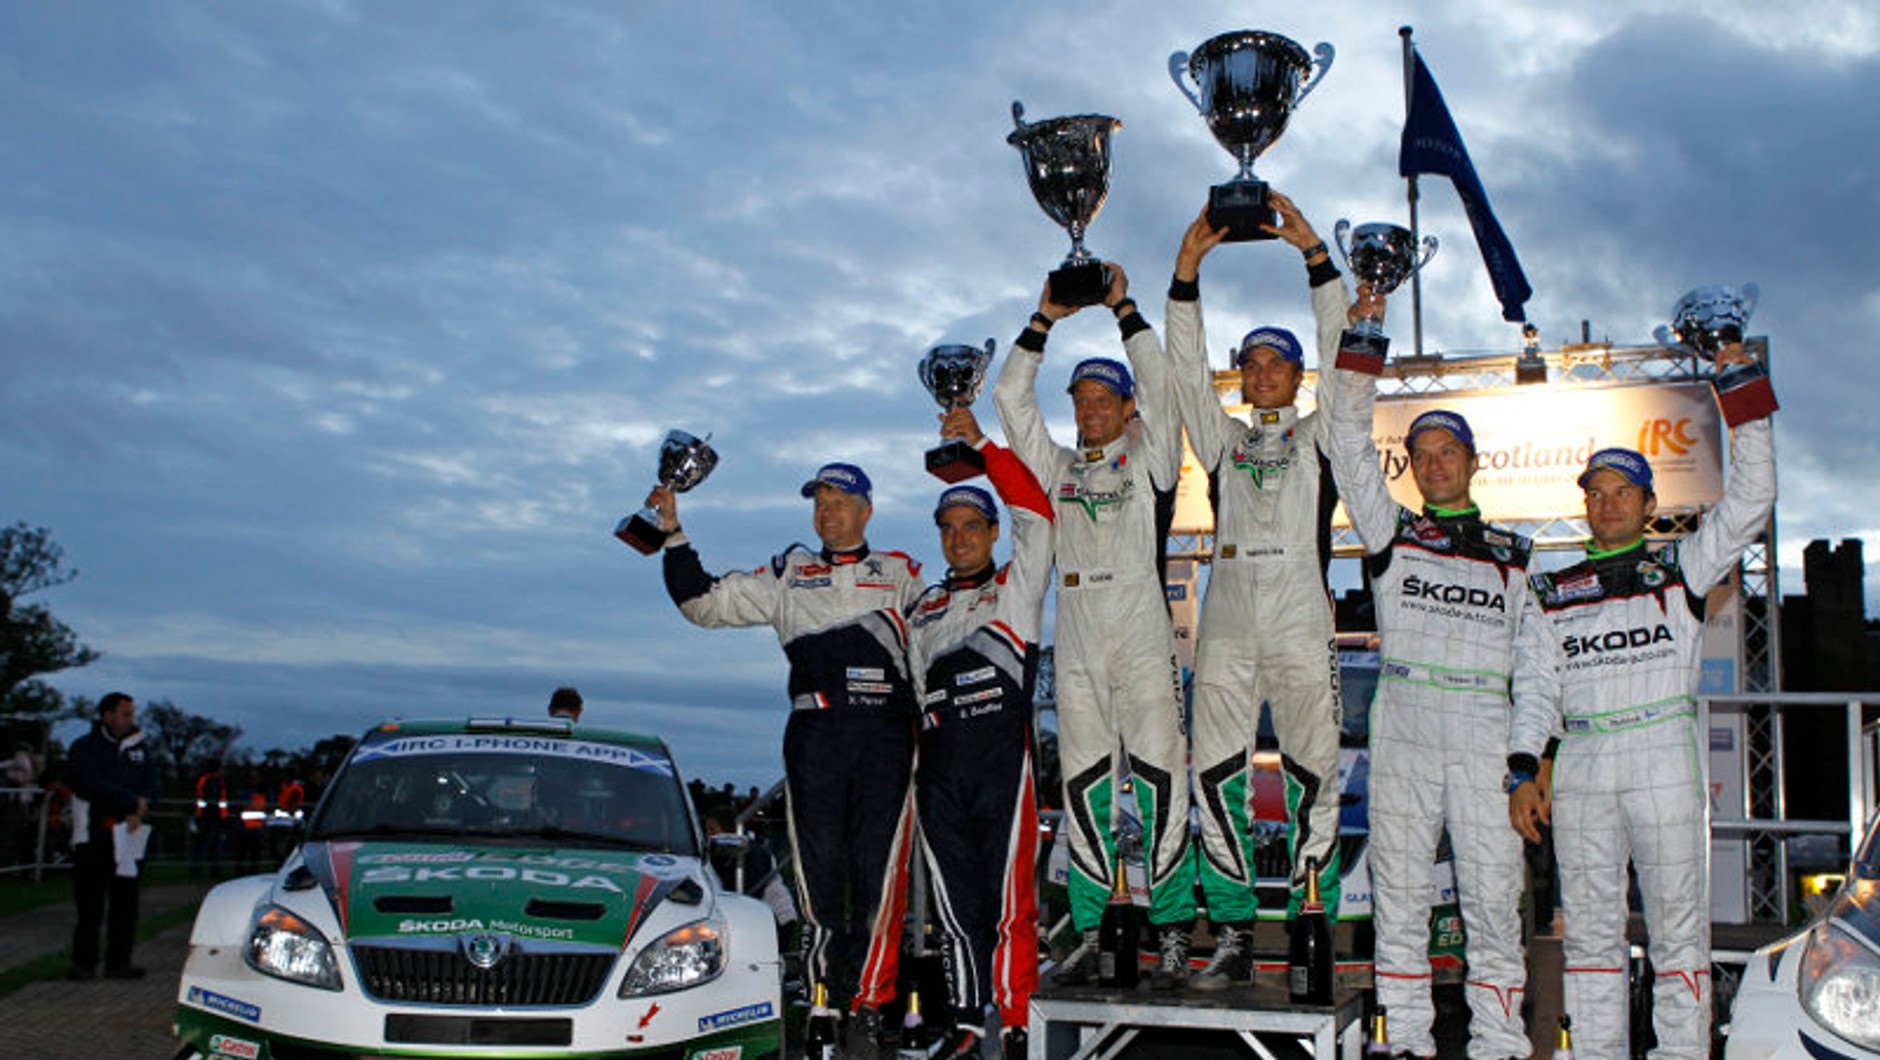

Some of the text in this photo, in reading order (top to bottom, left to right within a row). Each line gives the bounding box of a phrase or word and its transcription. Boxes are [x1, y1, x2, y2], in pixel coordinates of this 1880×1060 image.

[1476, 437, 1595, 471] cotland
[1402, 574, 1505, 613] ŠKODA
[1562, 624, 1674, 658] ŠKODA
[401, 737, 628, 763] IRC I-PHONE APP
[361, 865, 623, 892] ŠKODA
[398, 918, 574, 939] ŠKODA Motorsport
